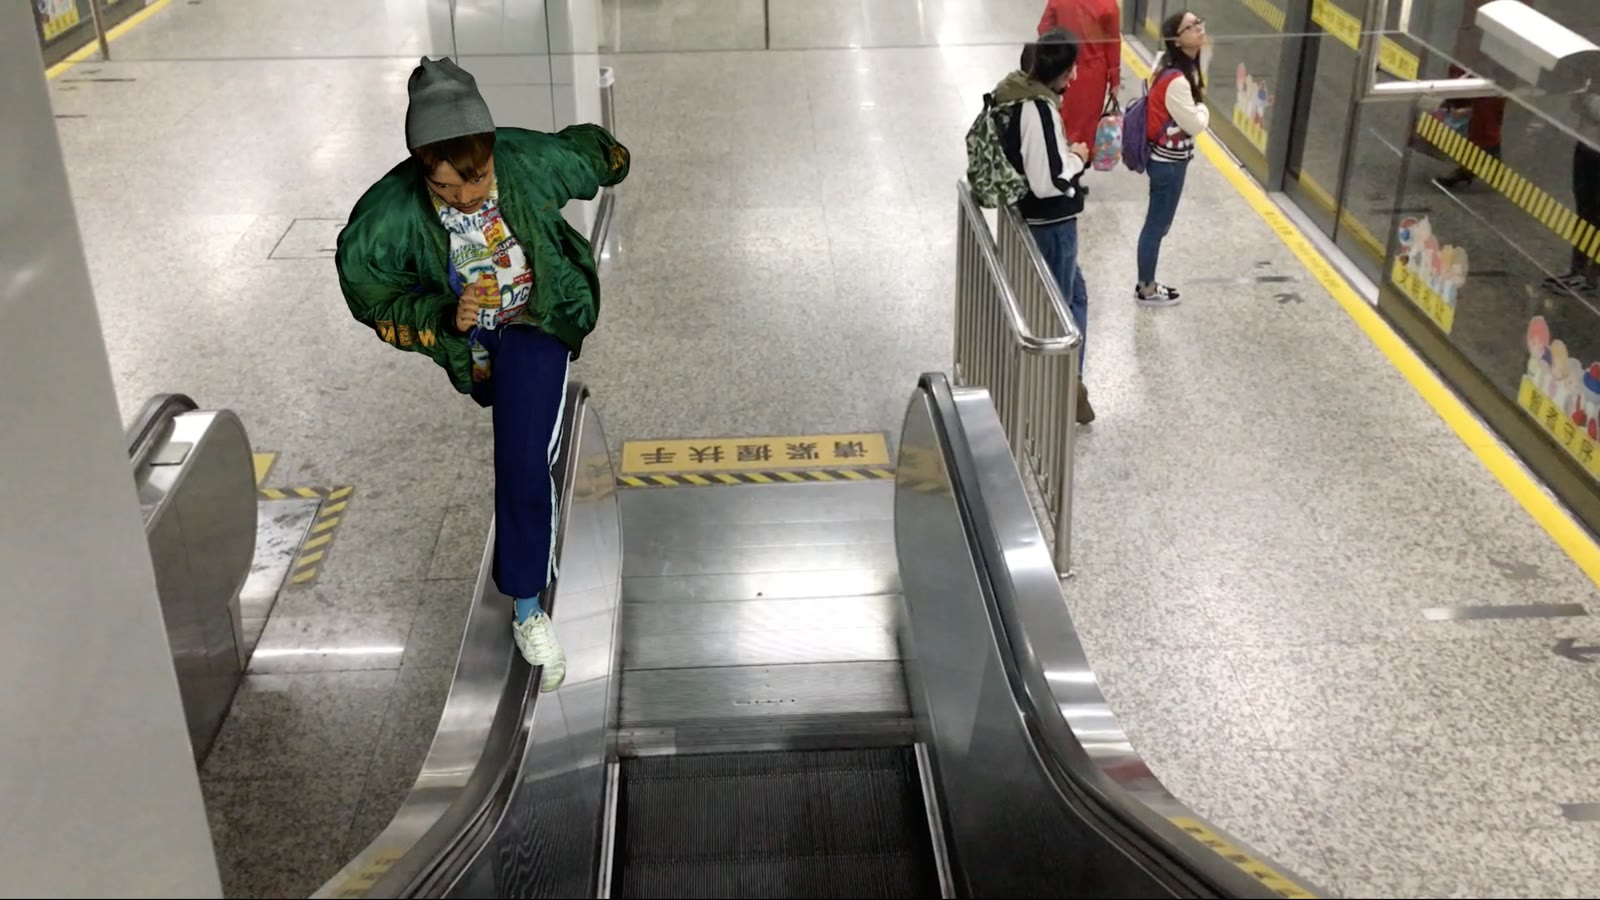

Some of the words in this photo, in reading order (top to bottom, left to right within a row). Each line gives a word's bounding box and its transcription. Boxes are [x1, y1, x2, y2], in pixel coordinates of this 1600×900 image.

[639, 439, 869, 466] 请紧握扶手
